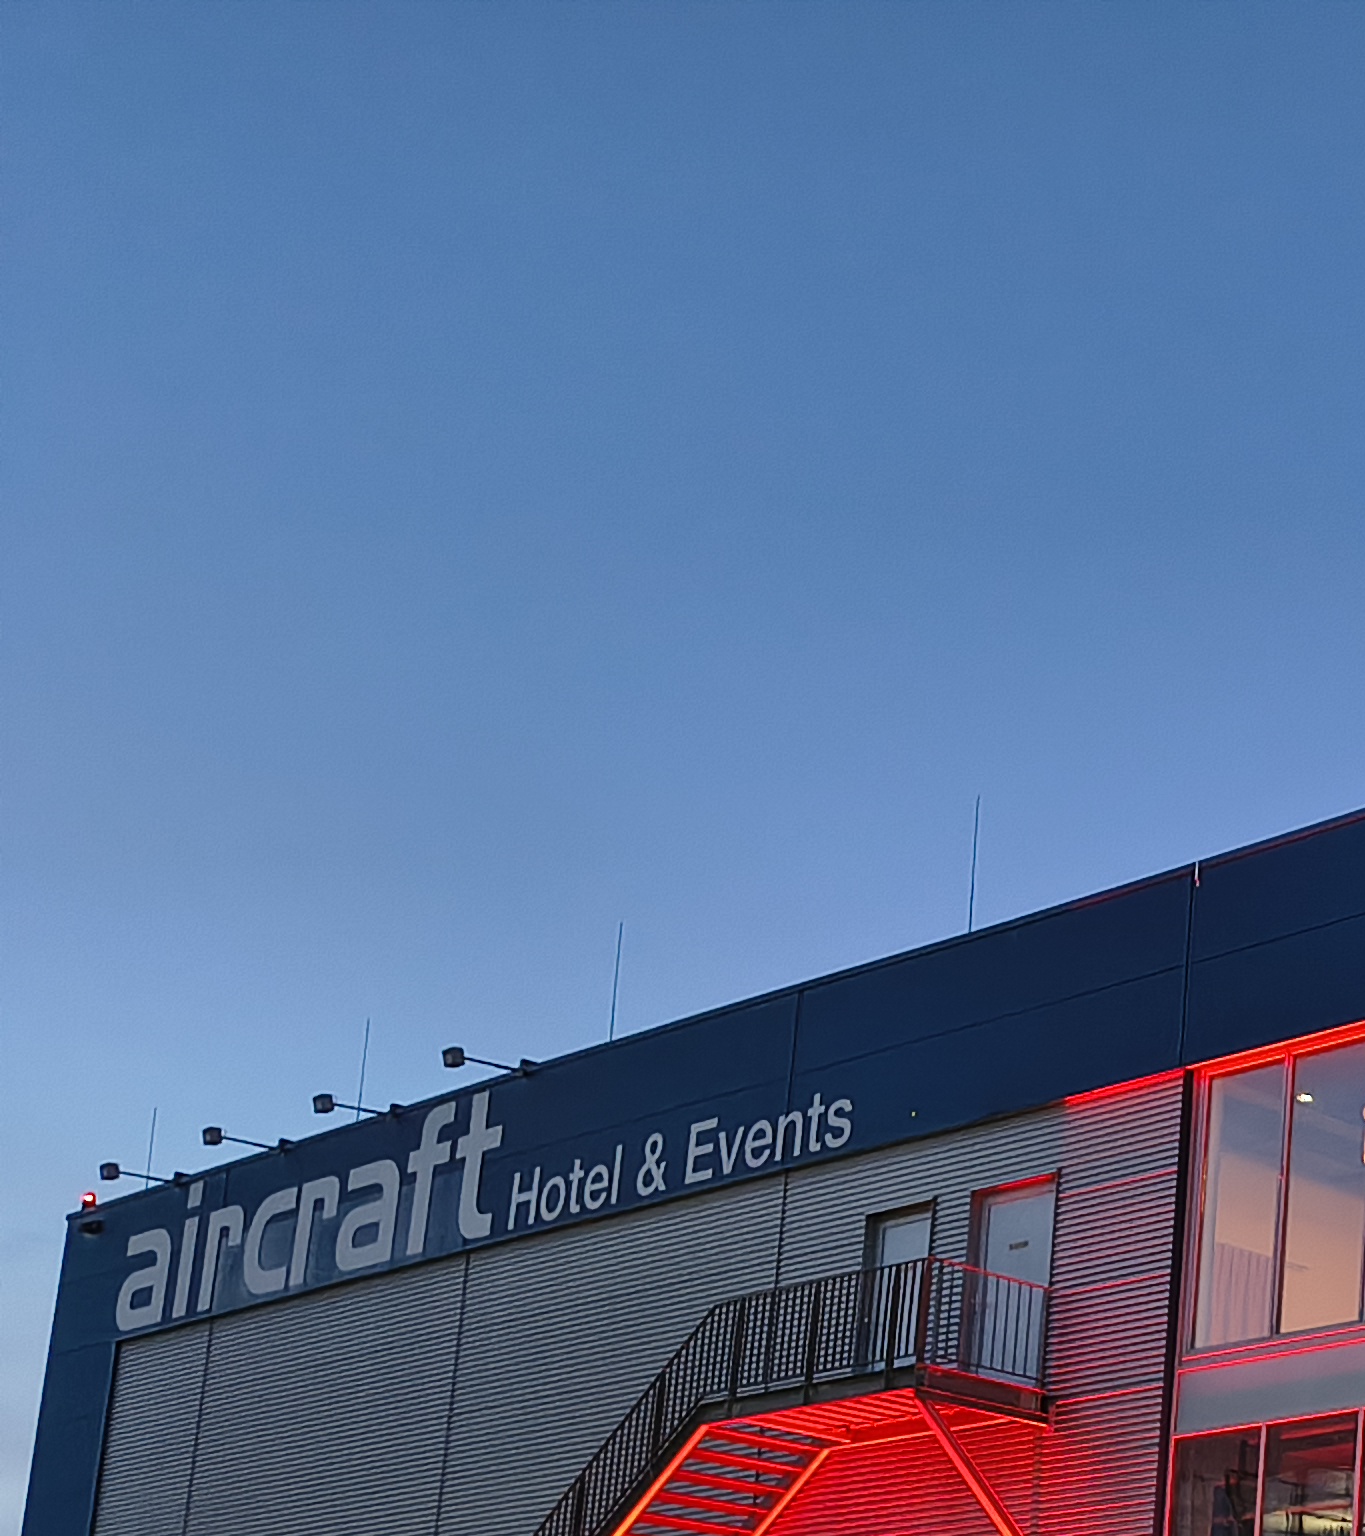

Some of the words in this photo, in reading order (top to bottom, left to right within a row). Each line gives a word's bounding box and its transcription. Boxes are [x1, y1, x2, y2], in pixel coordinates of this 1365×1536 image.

[115, 1091, 504, 1332] aircraft
[507, 1143, 624, 1230] Hotel
[636, 1132, 668, 1196] &
[684, 1092, 854, 1185] Events
